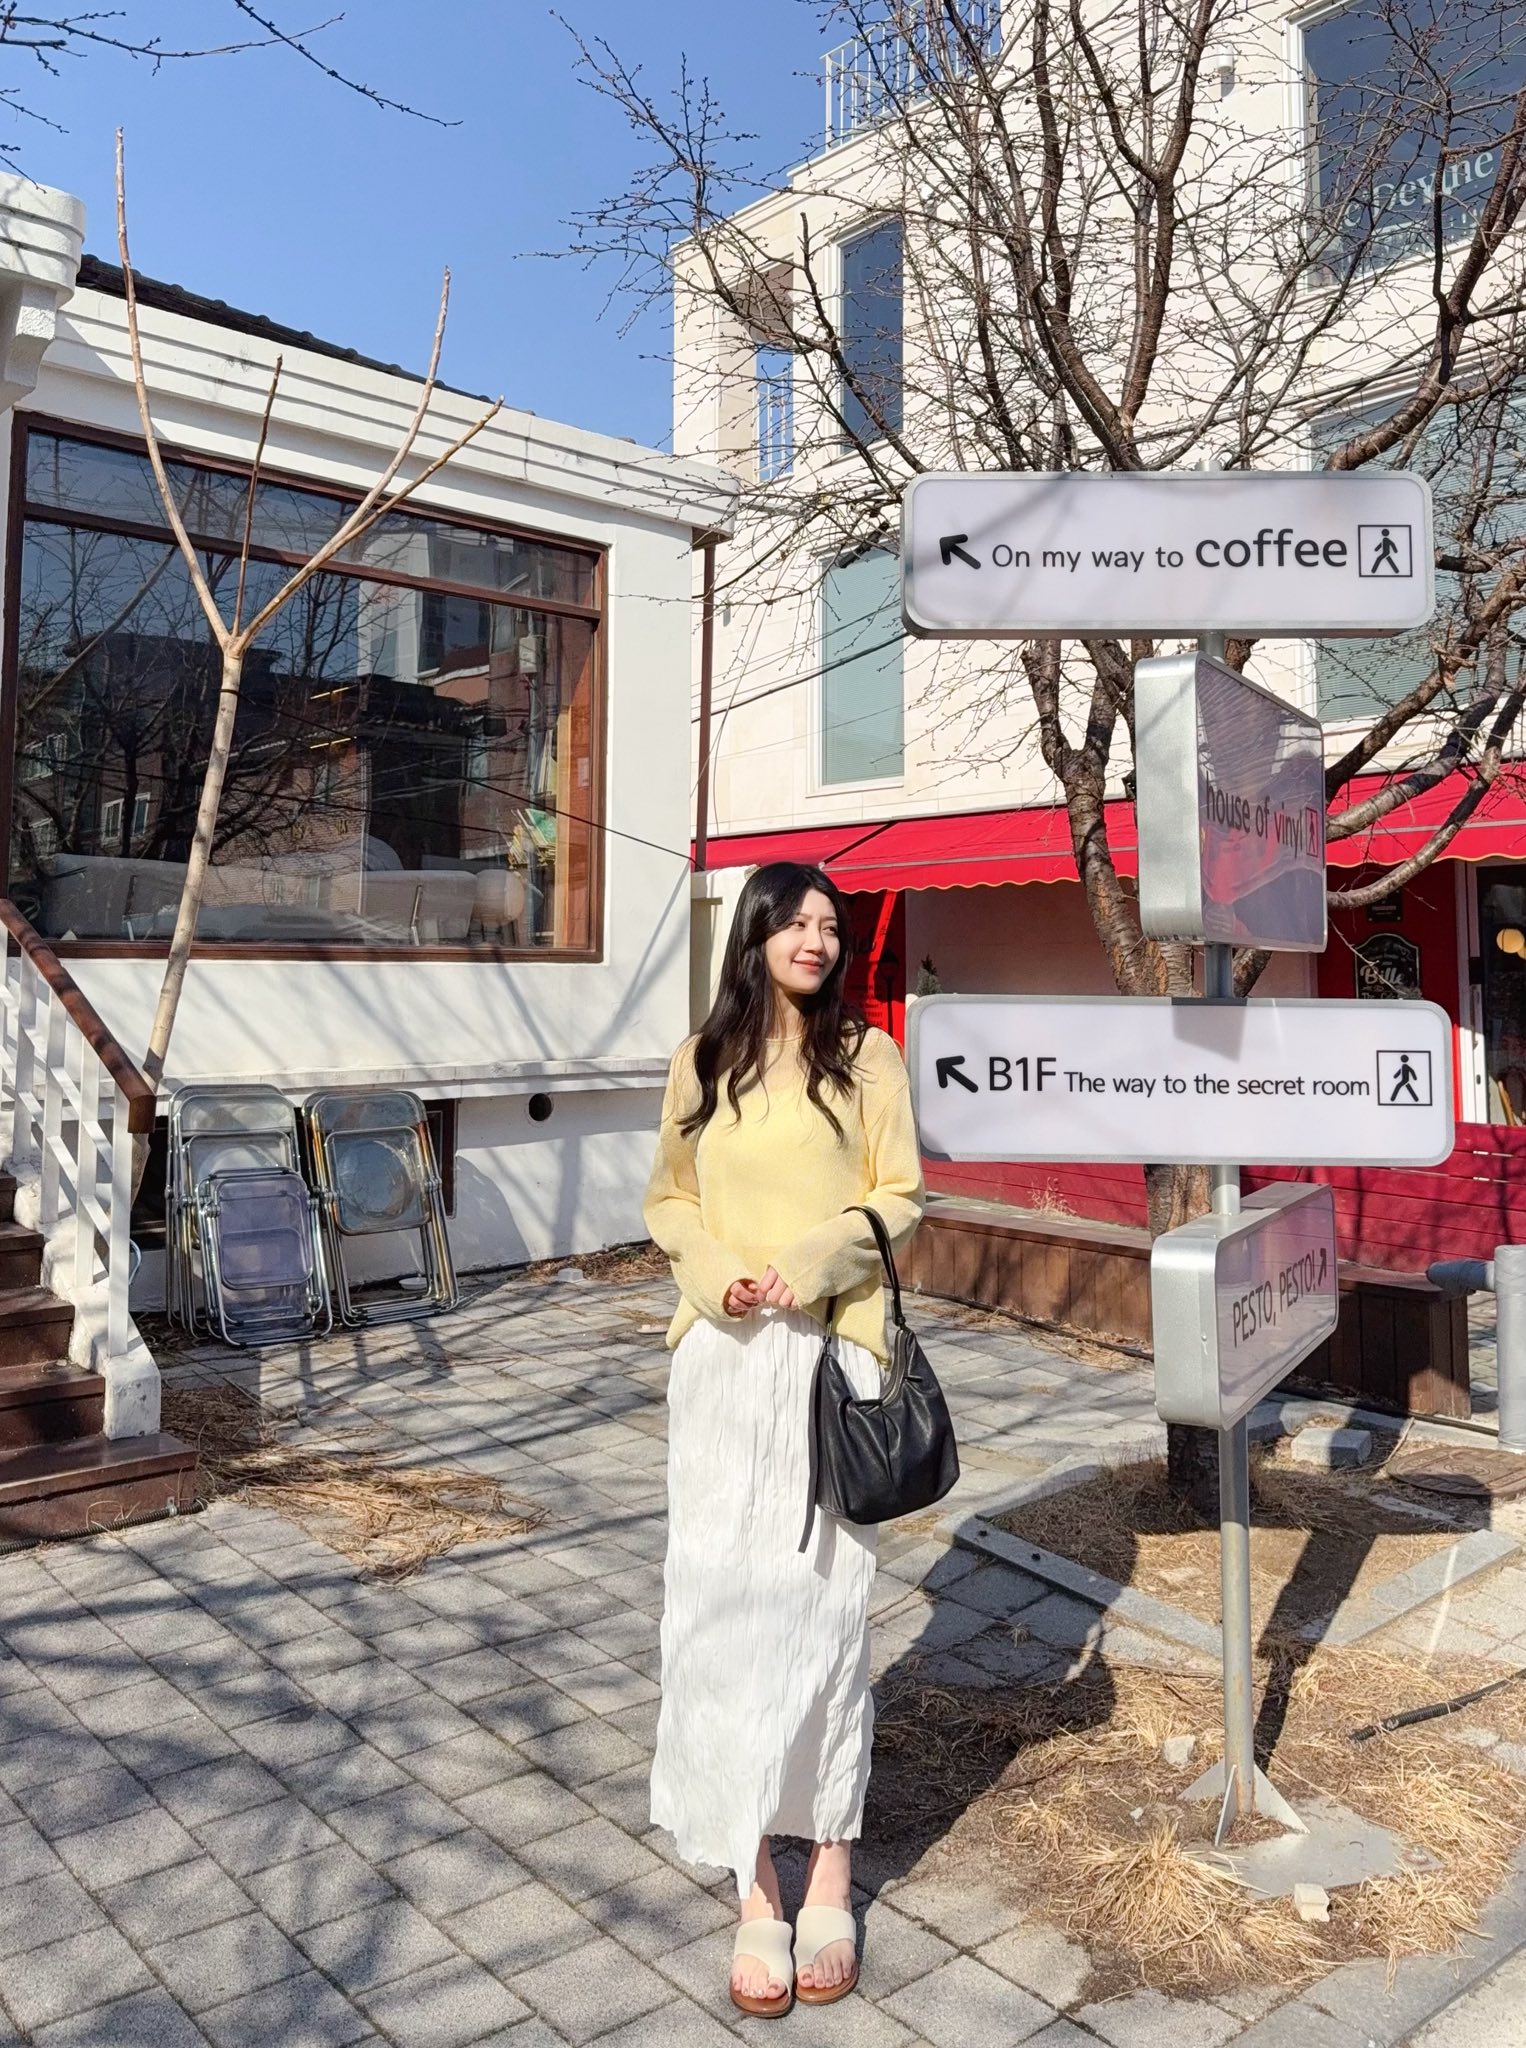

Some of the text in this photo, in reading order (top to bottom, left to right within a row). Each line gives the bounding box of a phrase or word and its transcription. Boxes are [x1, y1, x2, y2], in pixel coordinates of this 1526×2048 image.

[991, 528, 1348, 573] On my way to coffee
[1206, 770, 1303, 859] house of vinyl
[988, 1056, 1370, 1098] B1F The way to the secret room
[1233, 1249, 1316, 1349] PESTO, PESTO!
